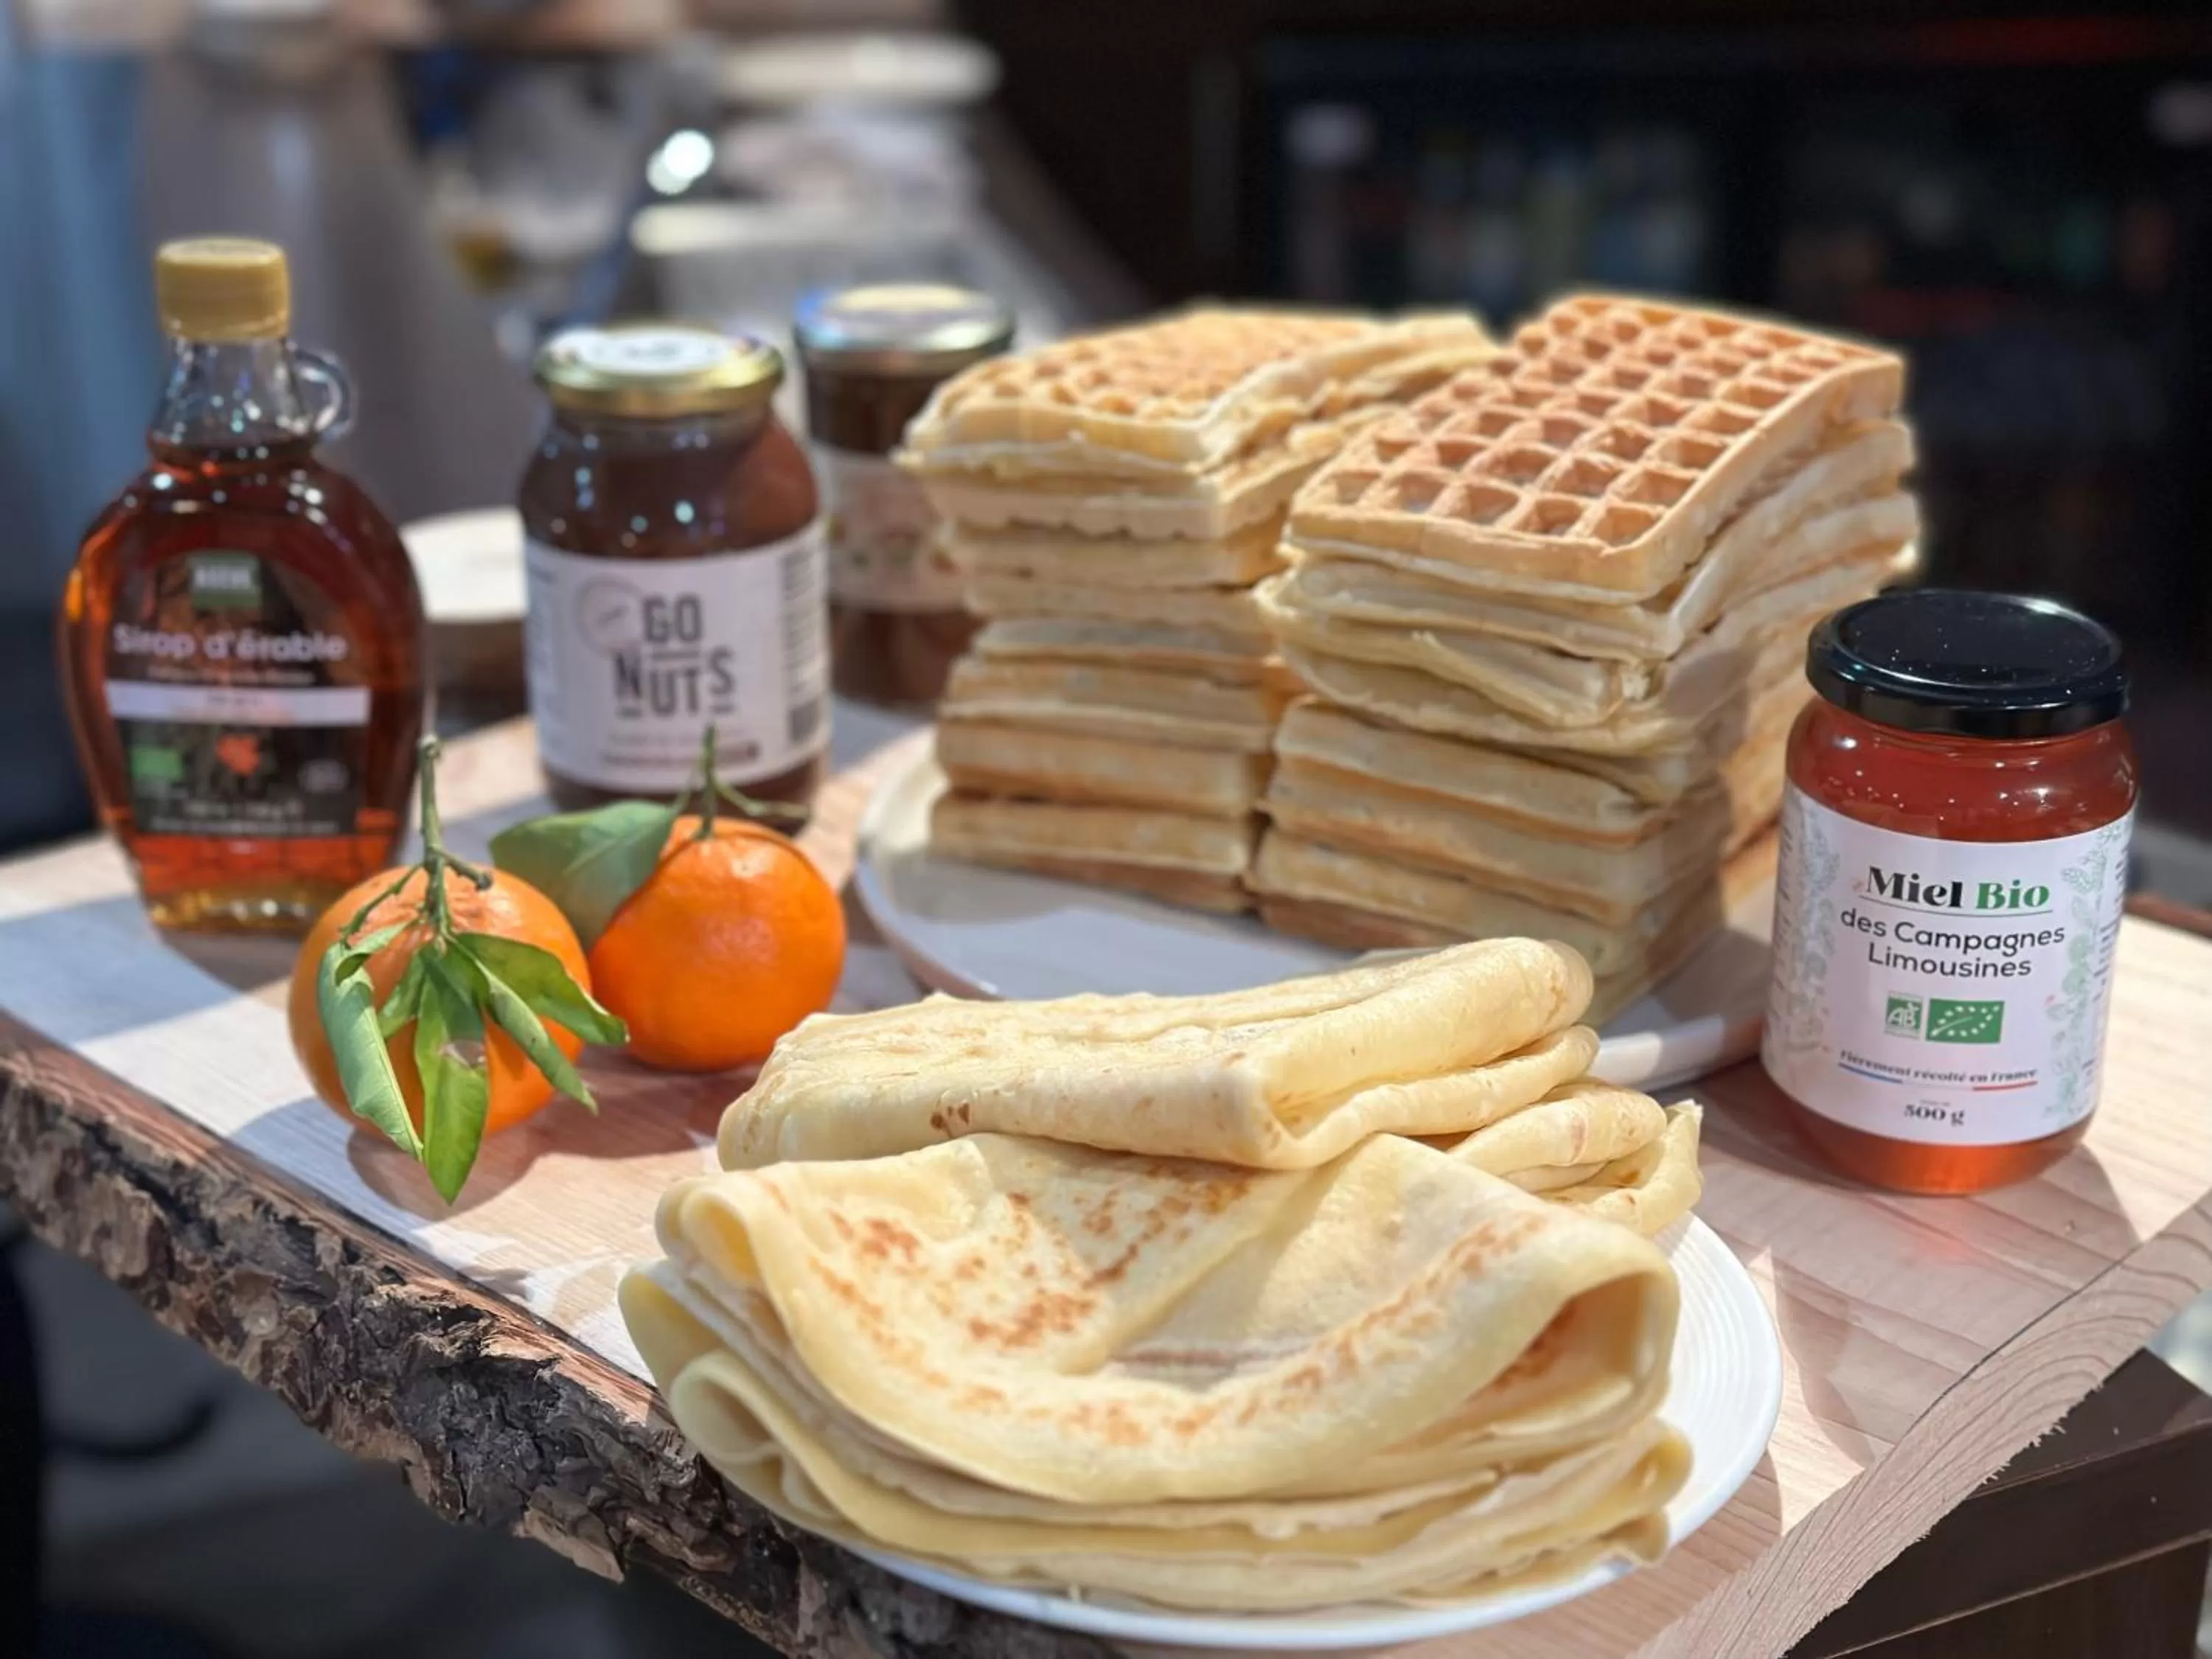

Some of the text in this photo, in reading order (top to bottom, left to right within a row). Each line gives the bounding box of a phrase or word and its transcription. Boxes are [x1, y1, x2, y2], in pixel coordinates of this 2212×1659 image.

[643, 594, 703, 644] GO
[613, 647, 736, 717] NUTS
[1866, 866, 2050, 909] Miel Bio
[1840, 908, 2065, 958] des Campagnes
[1868, 942, 2032, 978] Limousines
[1905, 1104, 1965, 1127] 500 g
